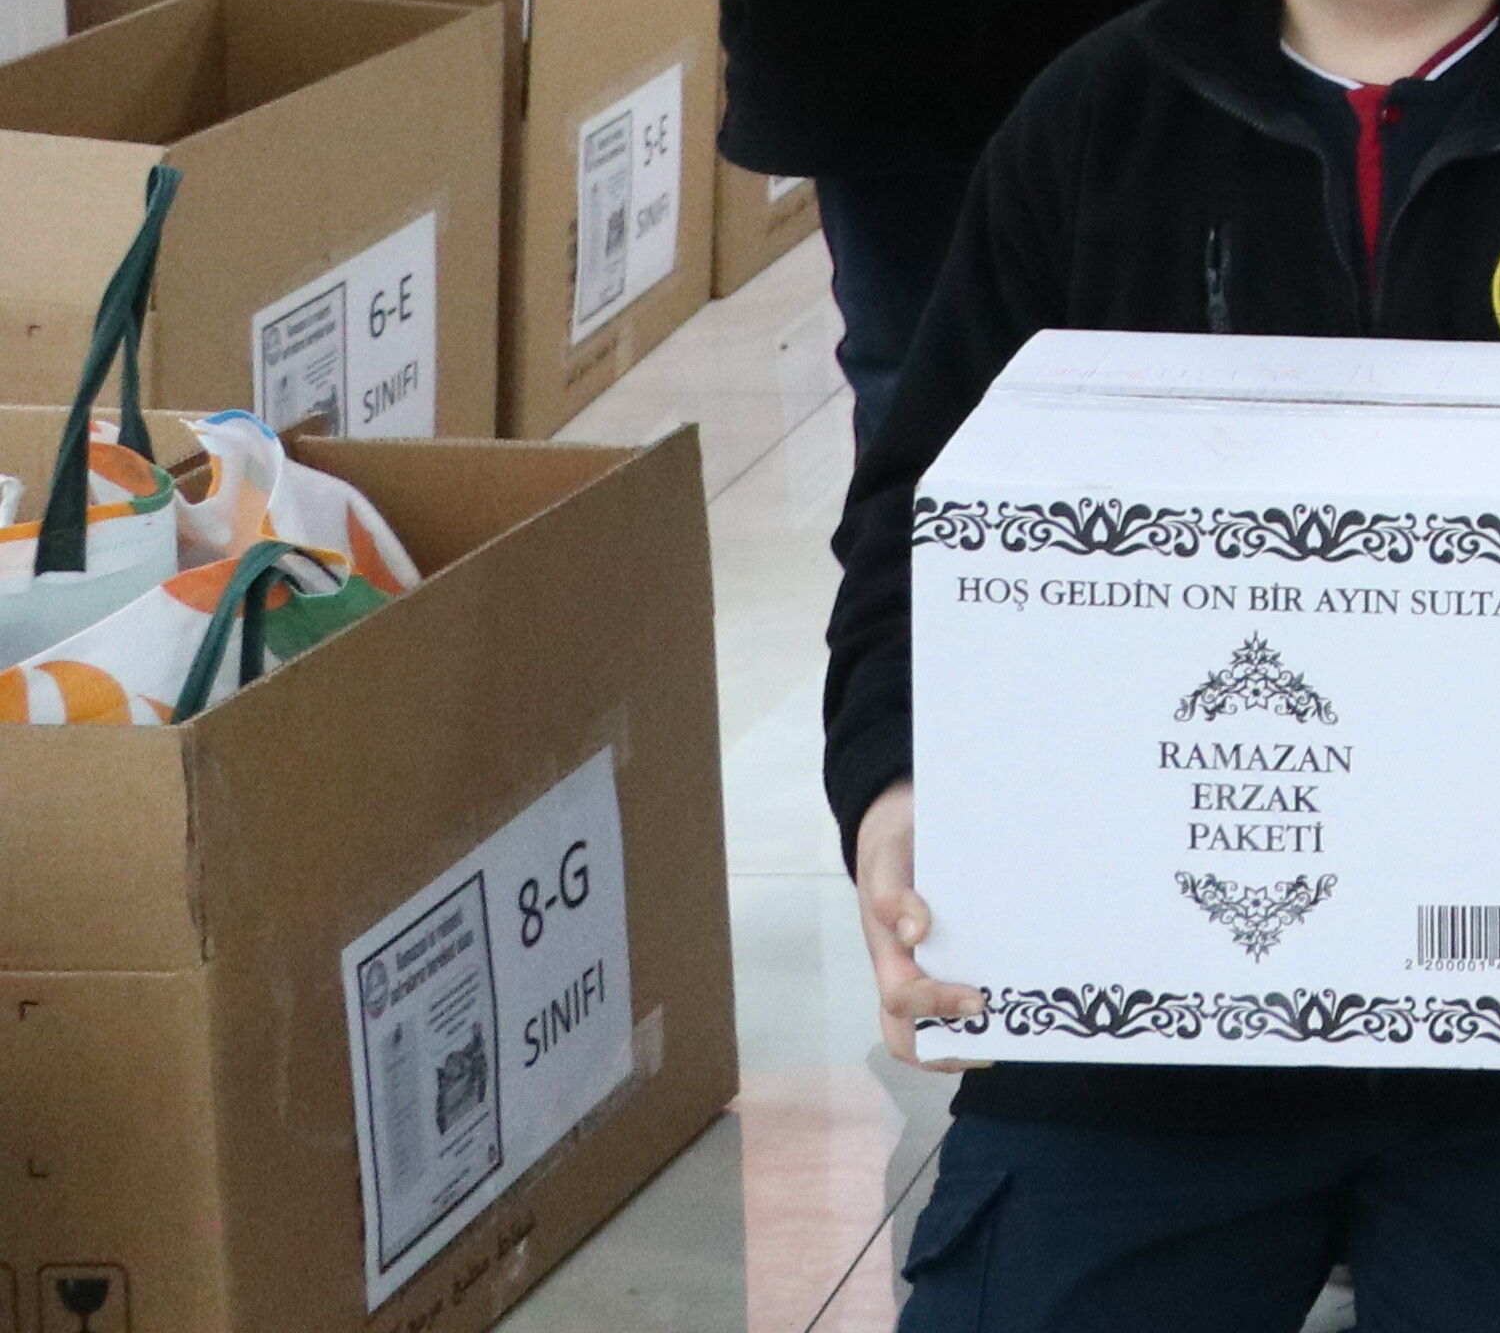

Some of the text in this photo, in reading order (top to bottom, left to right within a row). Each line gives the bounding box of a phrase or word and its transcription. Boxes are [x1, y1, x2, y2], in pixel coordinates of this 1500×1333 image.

[369, 273, 413, 338] 6-E
[362, 361, 418, 424] SINIFI
[958, 577, 1029, 610] HOŞ
[1040, 579, 1171, 608] GELDİN
[1182, 584, 1237, 610] ON
[1249, 583, 1303, 612] BİR
[1314, 588, 1399, 614] AYIN
[1159, 741, 1352, 773] RAMAZAN
[1192, 783, 1318, 813] ERZAK
[1189, 821, 1323, 853] PAKETİ
[518, 840, 590, 949] 8-G
[1425, 960, 1485, 971] 200001
[522, 959, 606, 1068] SINIFI
